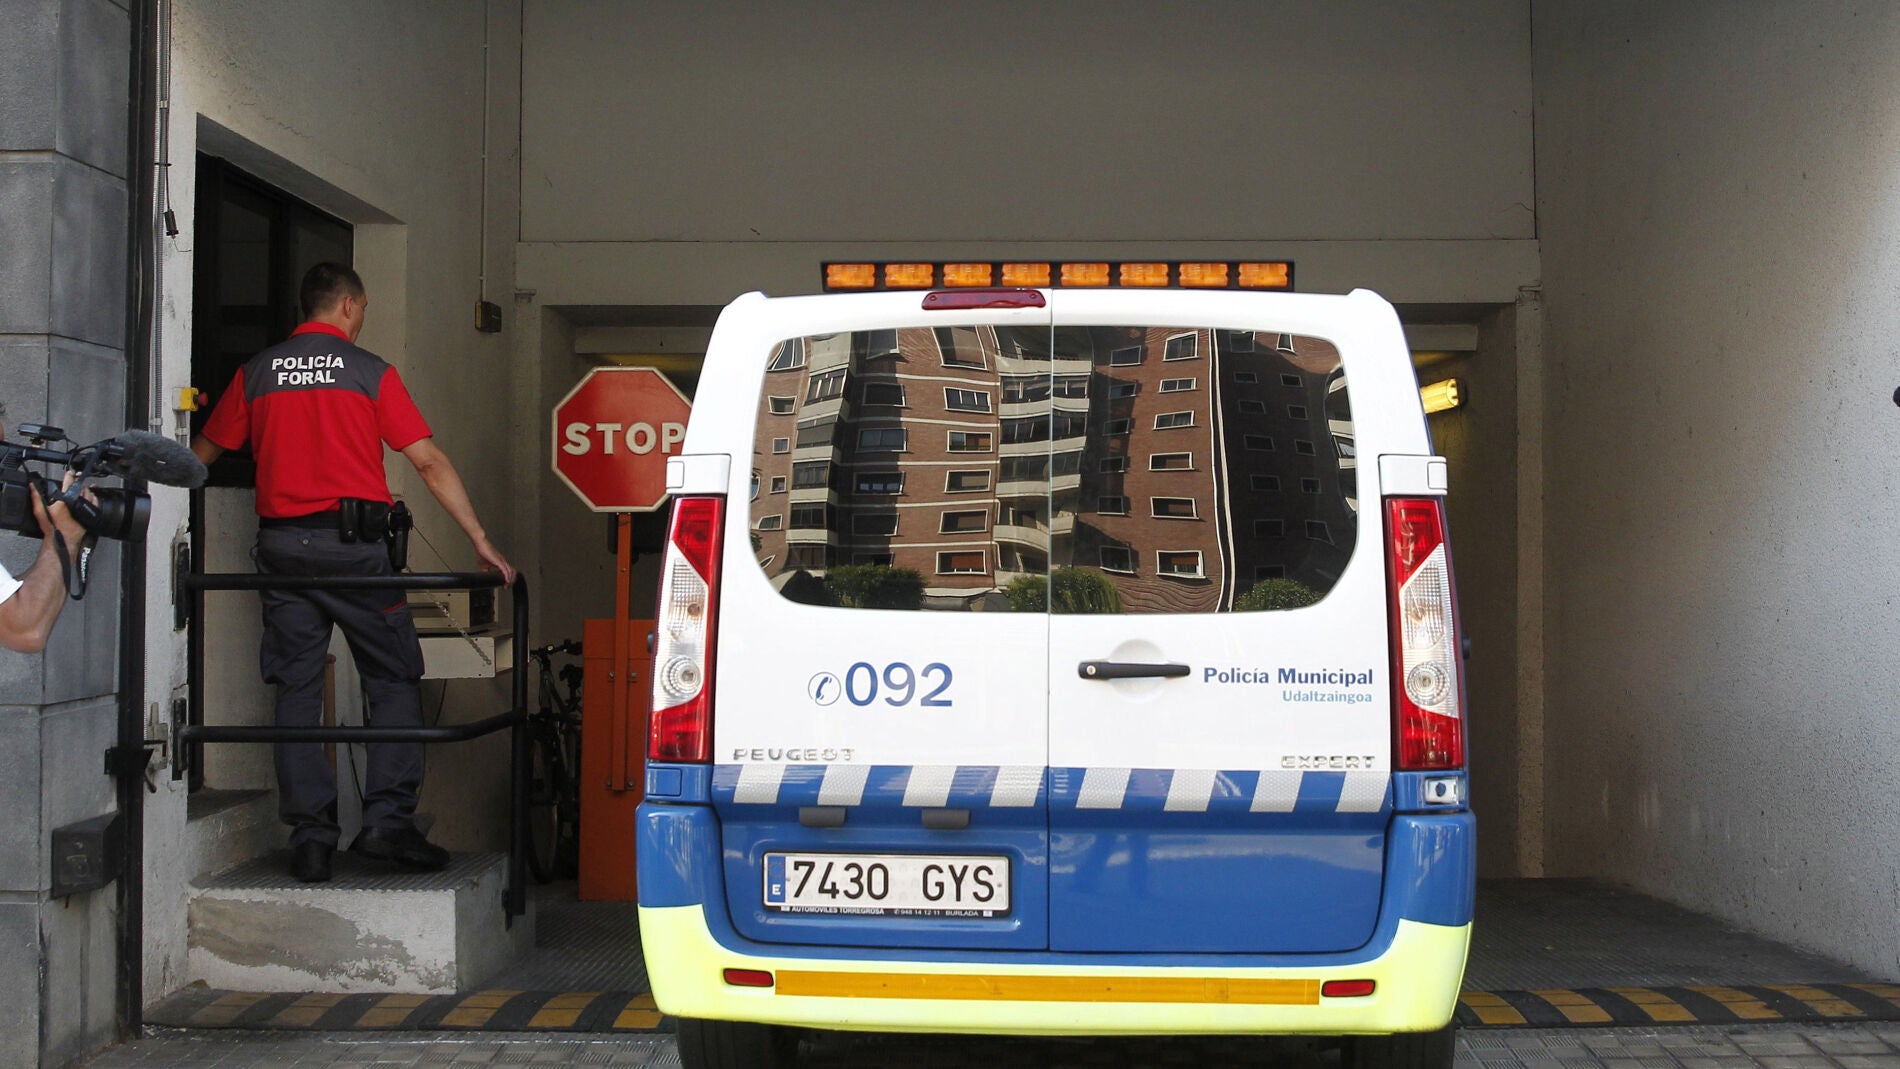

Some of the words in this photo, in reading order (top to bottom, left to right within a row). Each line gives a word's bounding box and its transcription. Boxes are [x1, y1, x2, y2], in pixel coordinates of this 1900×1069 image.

[271, 353, 345, 370] POLICÍA
[277, 370, 336, 386] FORAL
[562, 421, 686, 456] STOP
[845, 661, 953, 707] 092
[1203, 667, 1270, 684] Policía
[1277, 667, 1374, 688] Municipal
[1282, 689, 1373, 705] Udaltzaingoa
[733, 748, 855, 761] PEUGEOT
[1281, 755, 1376, 769] EXPERT
[772, 884, 781, 896] E
[793, 861, 889, 901] 7430
[922, 864, 995, 902] GYS
[791, 905, 838, 914] AUTOMOVILES
